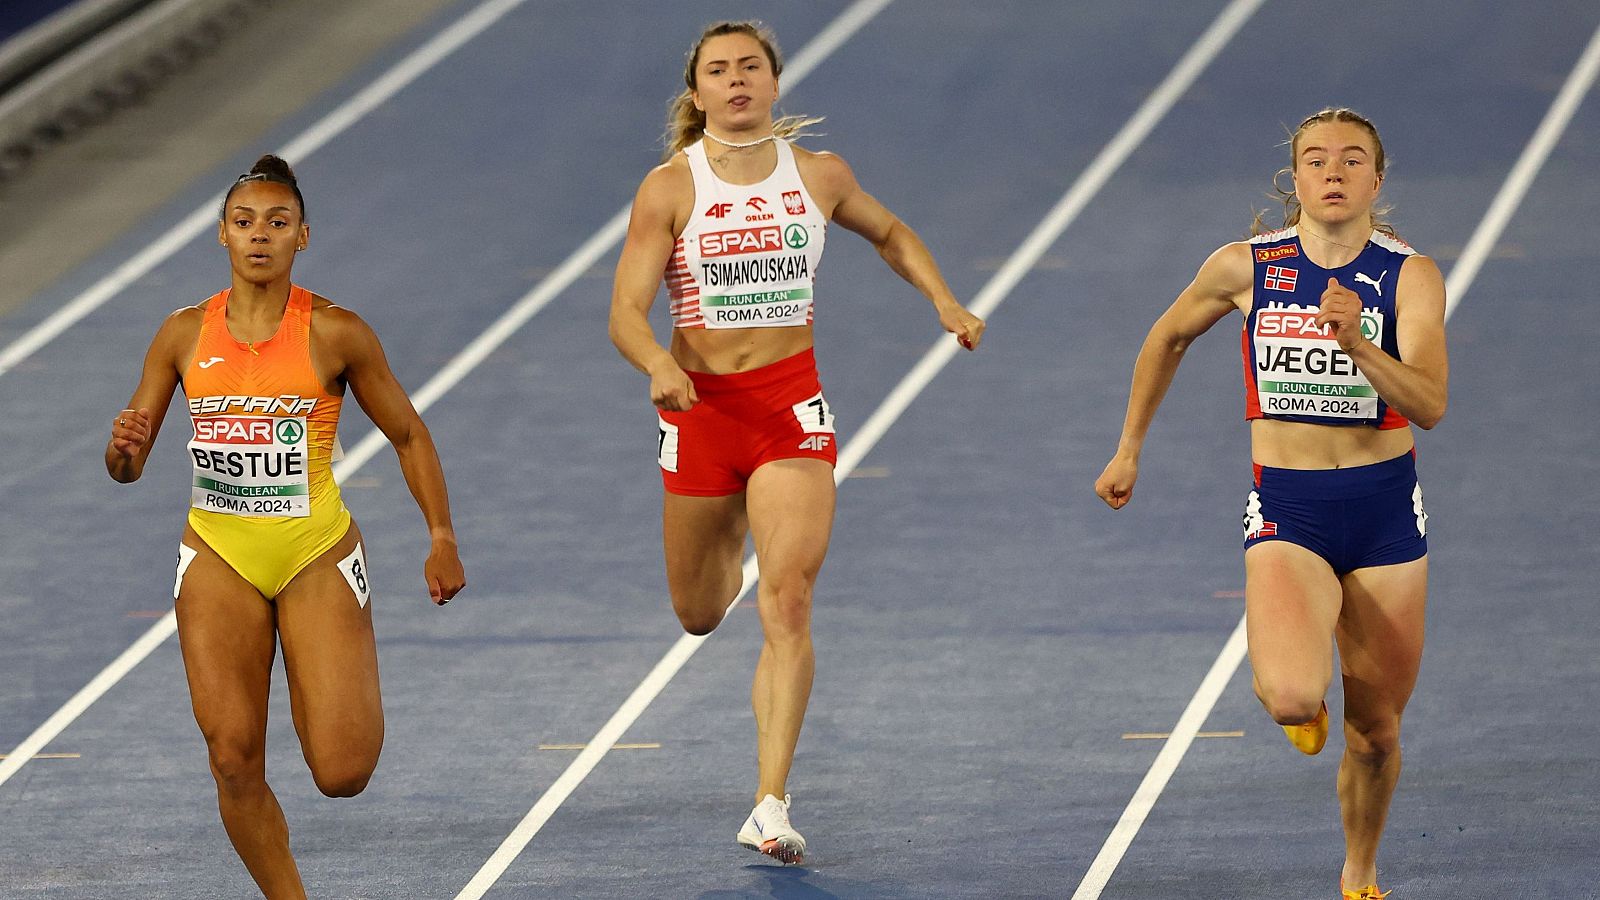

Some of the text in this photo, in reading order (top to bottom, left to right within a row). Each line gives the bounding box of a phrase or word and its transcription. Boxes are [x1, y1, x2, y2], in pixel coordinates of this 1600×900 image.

[704, 203, 734, 219] 4F
[745, 213, 775, 222] ORLEN
[701, 229, 781, 255] SPAR
[1270, 247, 1296, 257] EXTRA
[701, 254, 808, 287] TSIMANOUSKAYA
[723, 297, 727, 306] I
[729, 295, 752, 305] RUN
[716, 304, 799, 322] ROMA 2024
[1260, 315, 1332, 337] SPA
[1276, 383, 1280, 392] I
[1282, 382, 1307, 393] RUN
[189, 394, 318, 415] ESPAÑA
[807, 398, 825, 426] 7
[1268, 397, 1360, 414] ROMA 2024
[196, 421, 272, 441] SPAR
[798, 435, 830, 451] 4F
[191, 447, 303, 478] BESTUÉ
[218, 483, 239, 495] RUN
[206, 493, 292, 513] ROMA 2024
[351, 558, 367, 595] 8
